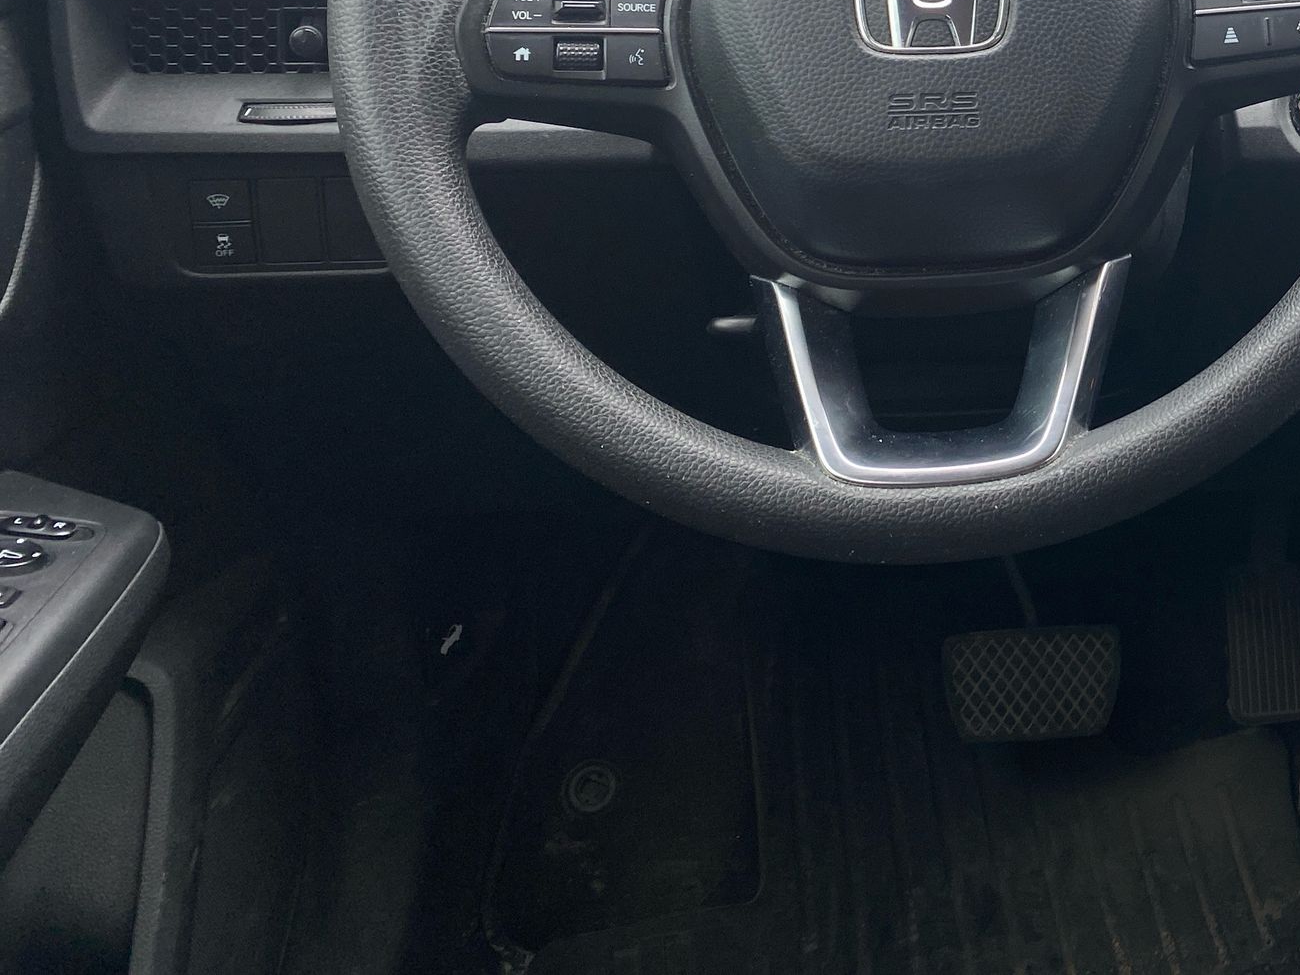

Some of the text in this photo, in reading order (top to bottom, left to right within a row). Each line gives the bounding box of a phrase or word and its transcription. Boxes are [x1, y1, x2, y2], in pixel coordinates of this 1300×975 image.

[617, 3, 657, 13] SOURCE
[887, 91, 979, 112] SRS
[887, 113, 981, 131] AIRBAG
[215, 249, 235, 257] OFF
